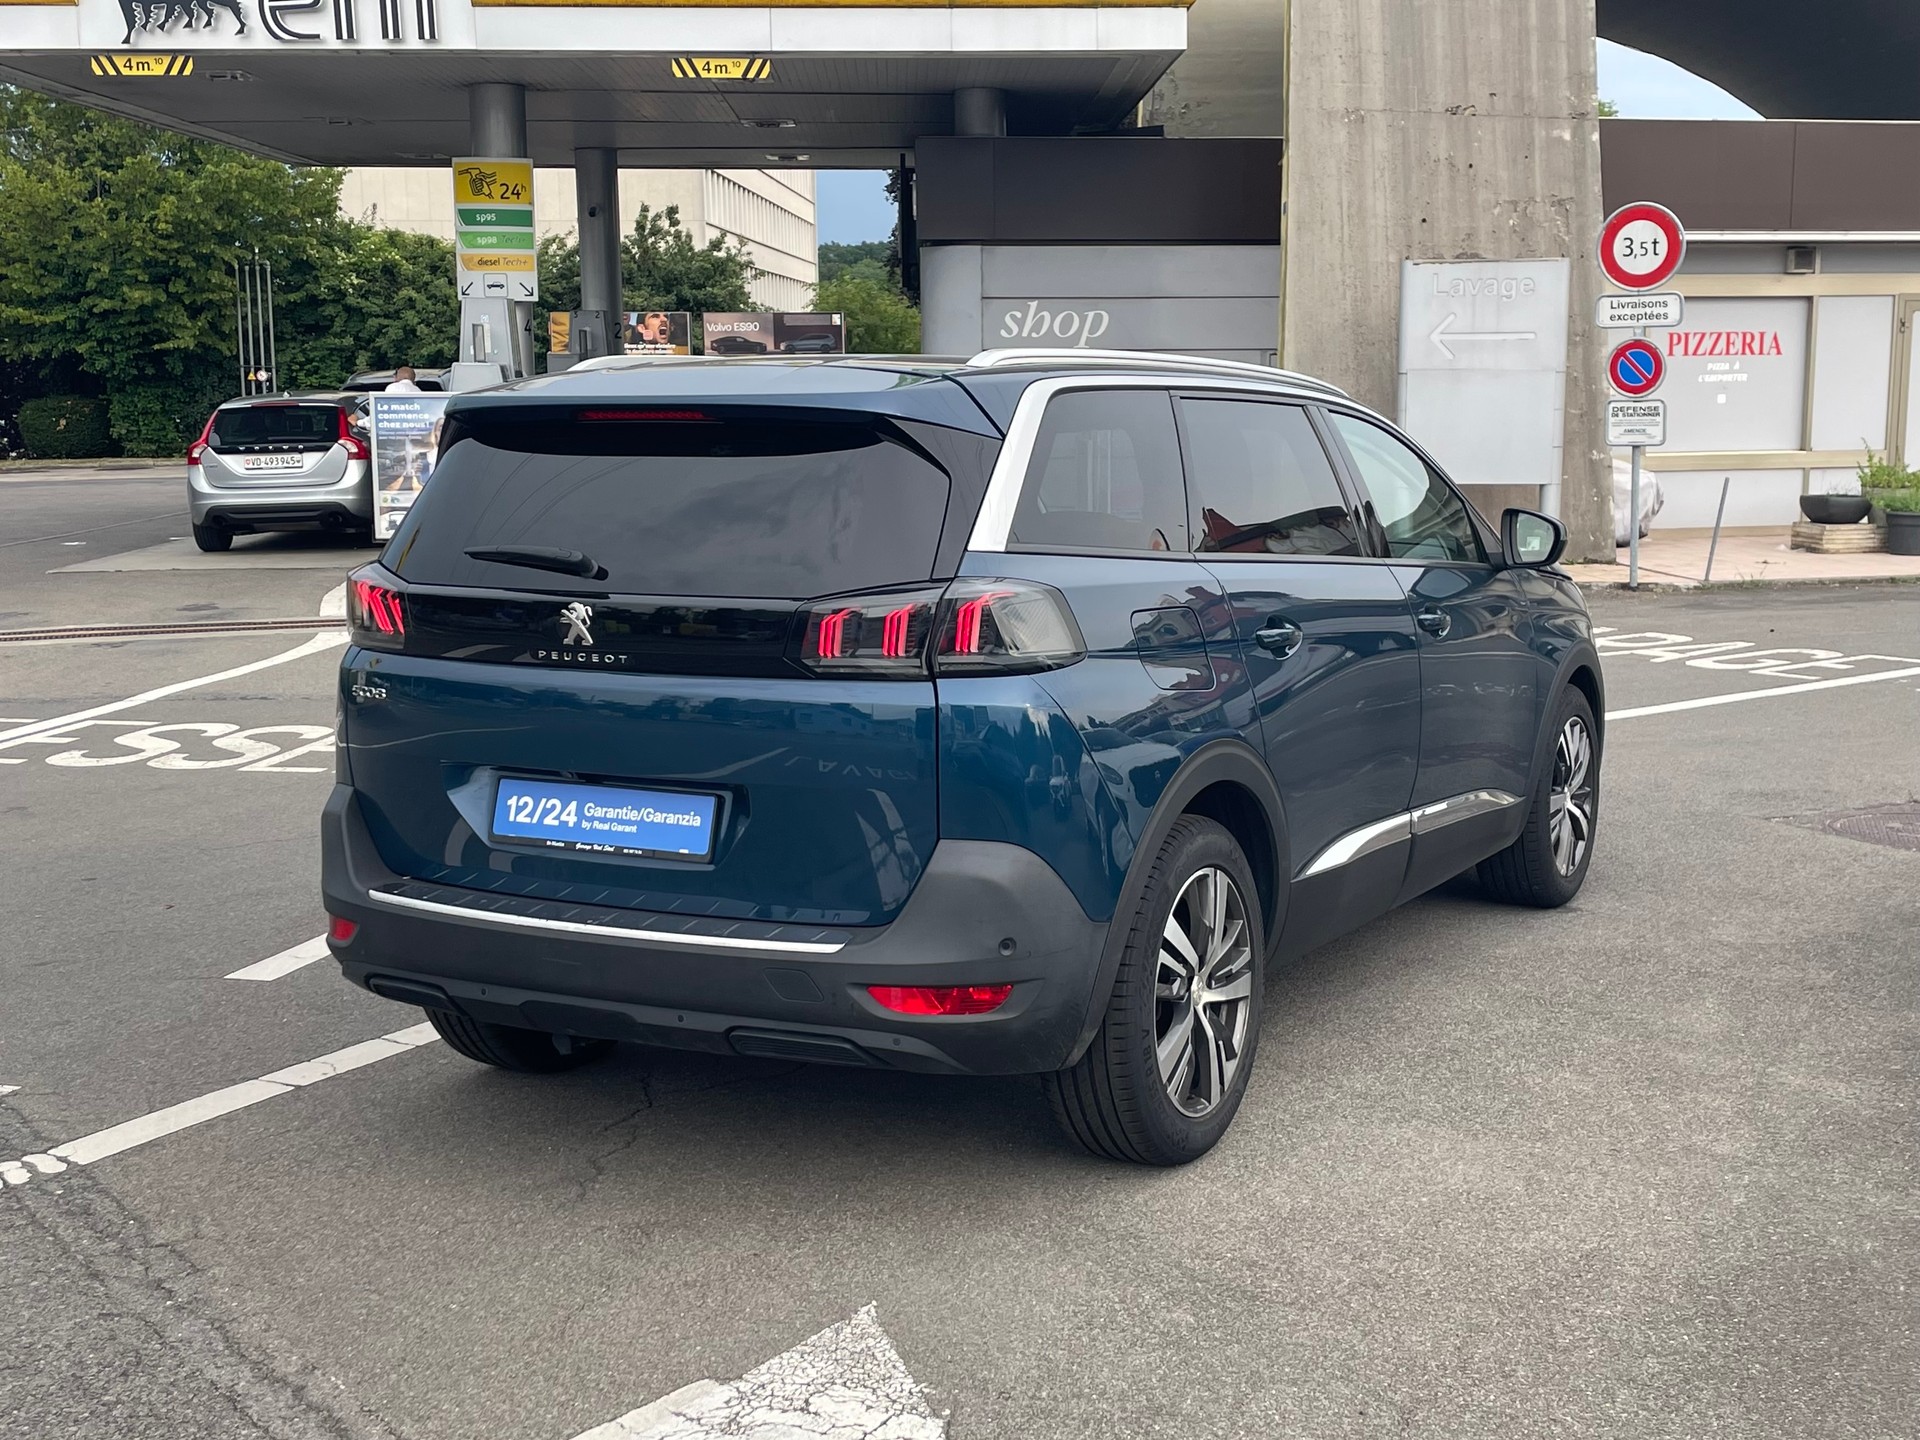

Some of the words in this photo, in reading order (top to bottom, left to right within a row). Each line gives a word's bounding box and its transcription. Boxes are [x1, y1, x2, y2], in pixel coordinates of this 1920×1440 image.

[476, 213, 496, 223] sp95
[477, 257, 500, 266] diesel
[501, 257, 528, 266] Tech+
[1432, 273, 1536, 301] Lavage
[1610, 299, 1668, 310] Livraisons
[1609, 310, 1669, 323] exceptées
[524, 319, 532, 336] 4
[707, 322, 732, 332] Volvo
[733, 322, 760, 332] ES90
[1000, 300, 1109, 348] shop
[614, 322, 622, 340] 2
[1667, 331, 1783, 357] PIZZERIA
[1706, 362, 1730, 371] PIZZA
[1698, 373, 1748, 383] L'EMPORTER
[391, 403, 421, 411] match
[538, 650, 628, 664] PEUGEOT
[506, 795, 578, 827] 12/24
[583, 802, 702, 827] Garantie/Garanzia
[581, 819, 591, 831] by
[592, 821, 610, 832] Real
[611, 822, 638, 833] Garant
